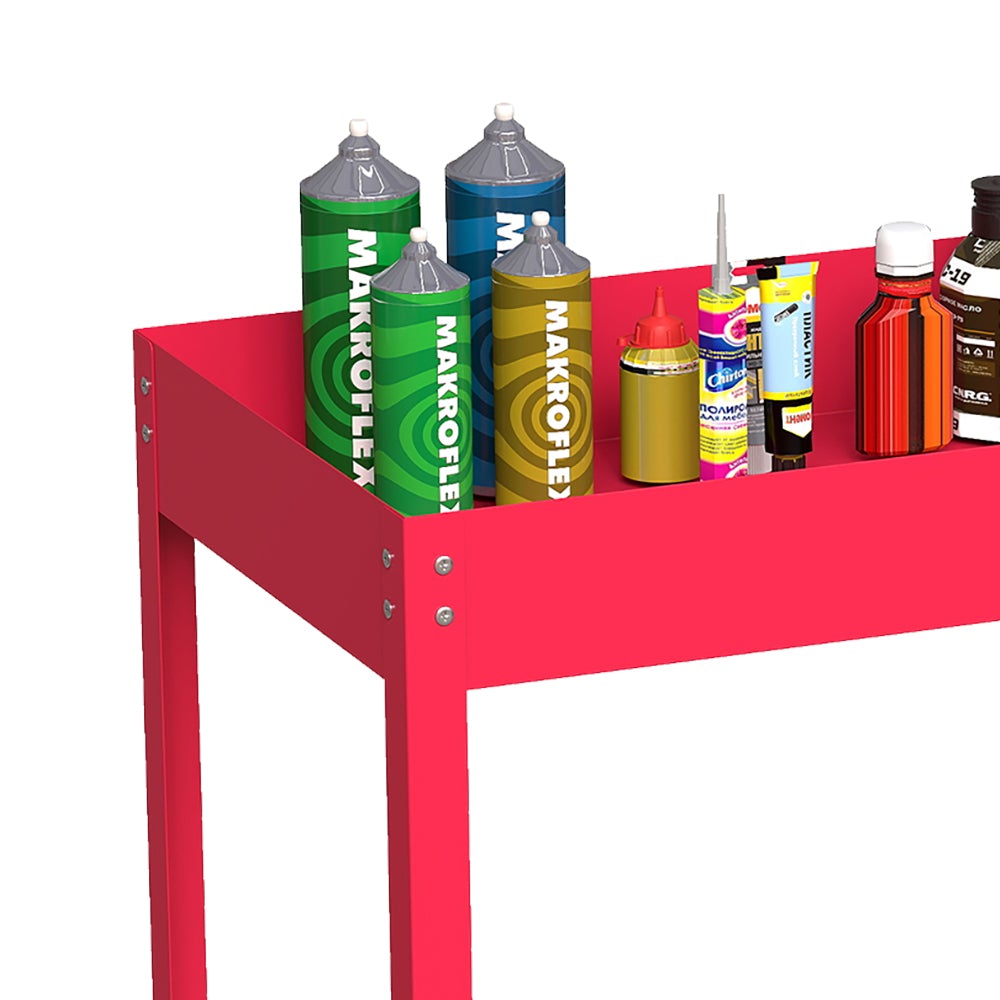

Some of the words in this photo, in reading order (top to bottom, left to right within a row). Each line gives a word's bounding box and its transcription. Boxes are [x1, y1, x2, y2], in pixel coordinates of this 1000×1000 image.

[496, 211, 525, 258] M
[347, 228, 378, 487] MAKROFLEX
[707, 368, 748, 388] Chirto
